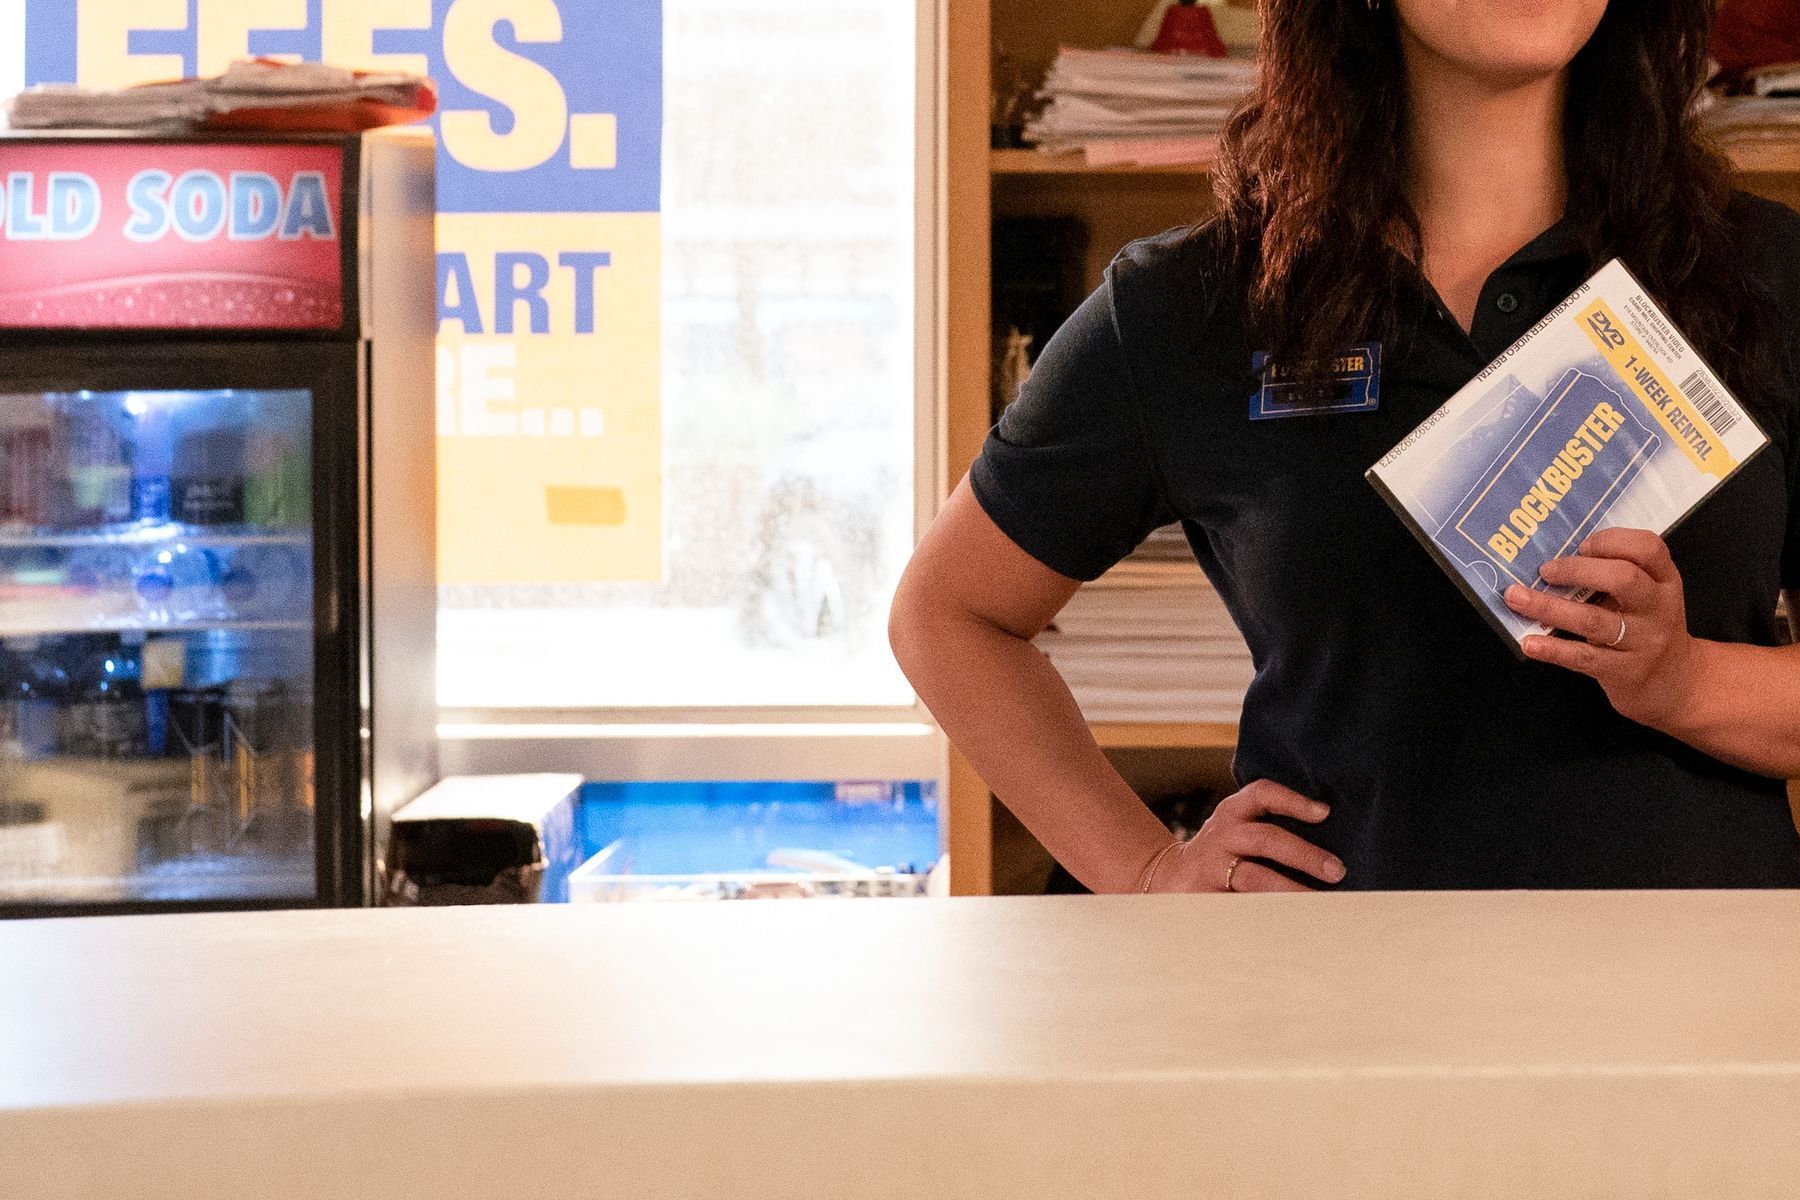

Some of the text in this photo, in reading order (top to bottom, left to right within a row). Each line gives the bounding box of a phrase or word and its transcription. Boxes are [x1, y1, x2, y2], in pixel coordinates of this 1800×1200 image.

[0, 169, 336, 242] LD SODA
[436, 252, 610, 334] ART
[1591, 309, 1627, 347] DVD
[1634, 294, 1685, 353] BLOCKBUSTER VIDEO
[1504, 331, 1533, 358] VIDEO
[1621, 354, 1715, 461] 1-WEEK RENTAL
[1488, 402, 1625, 563] BLOCKBUSTER
